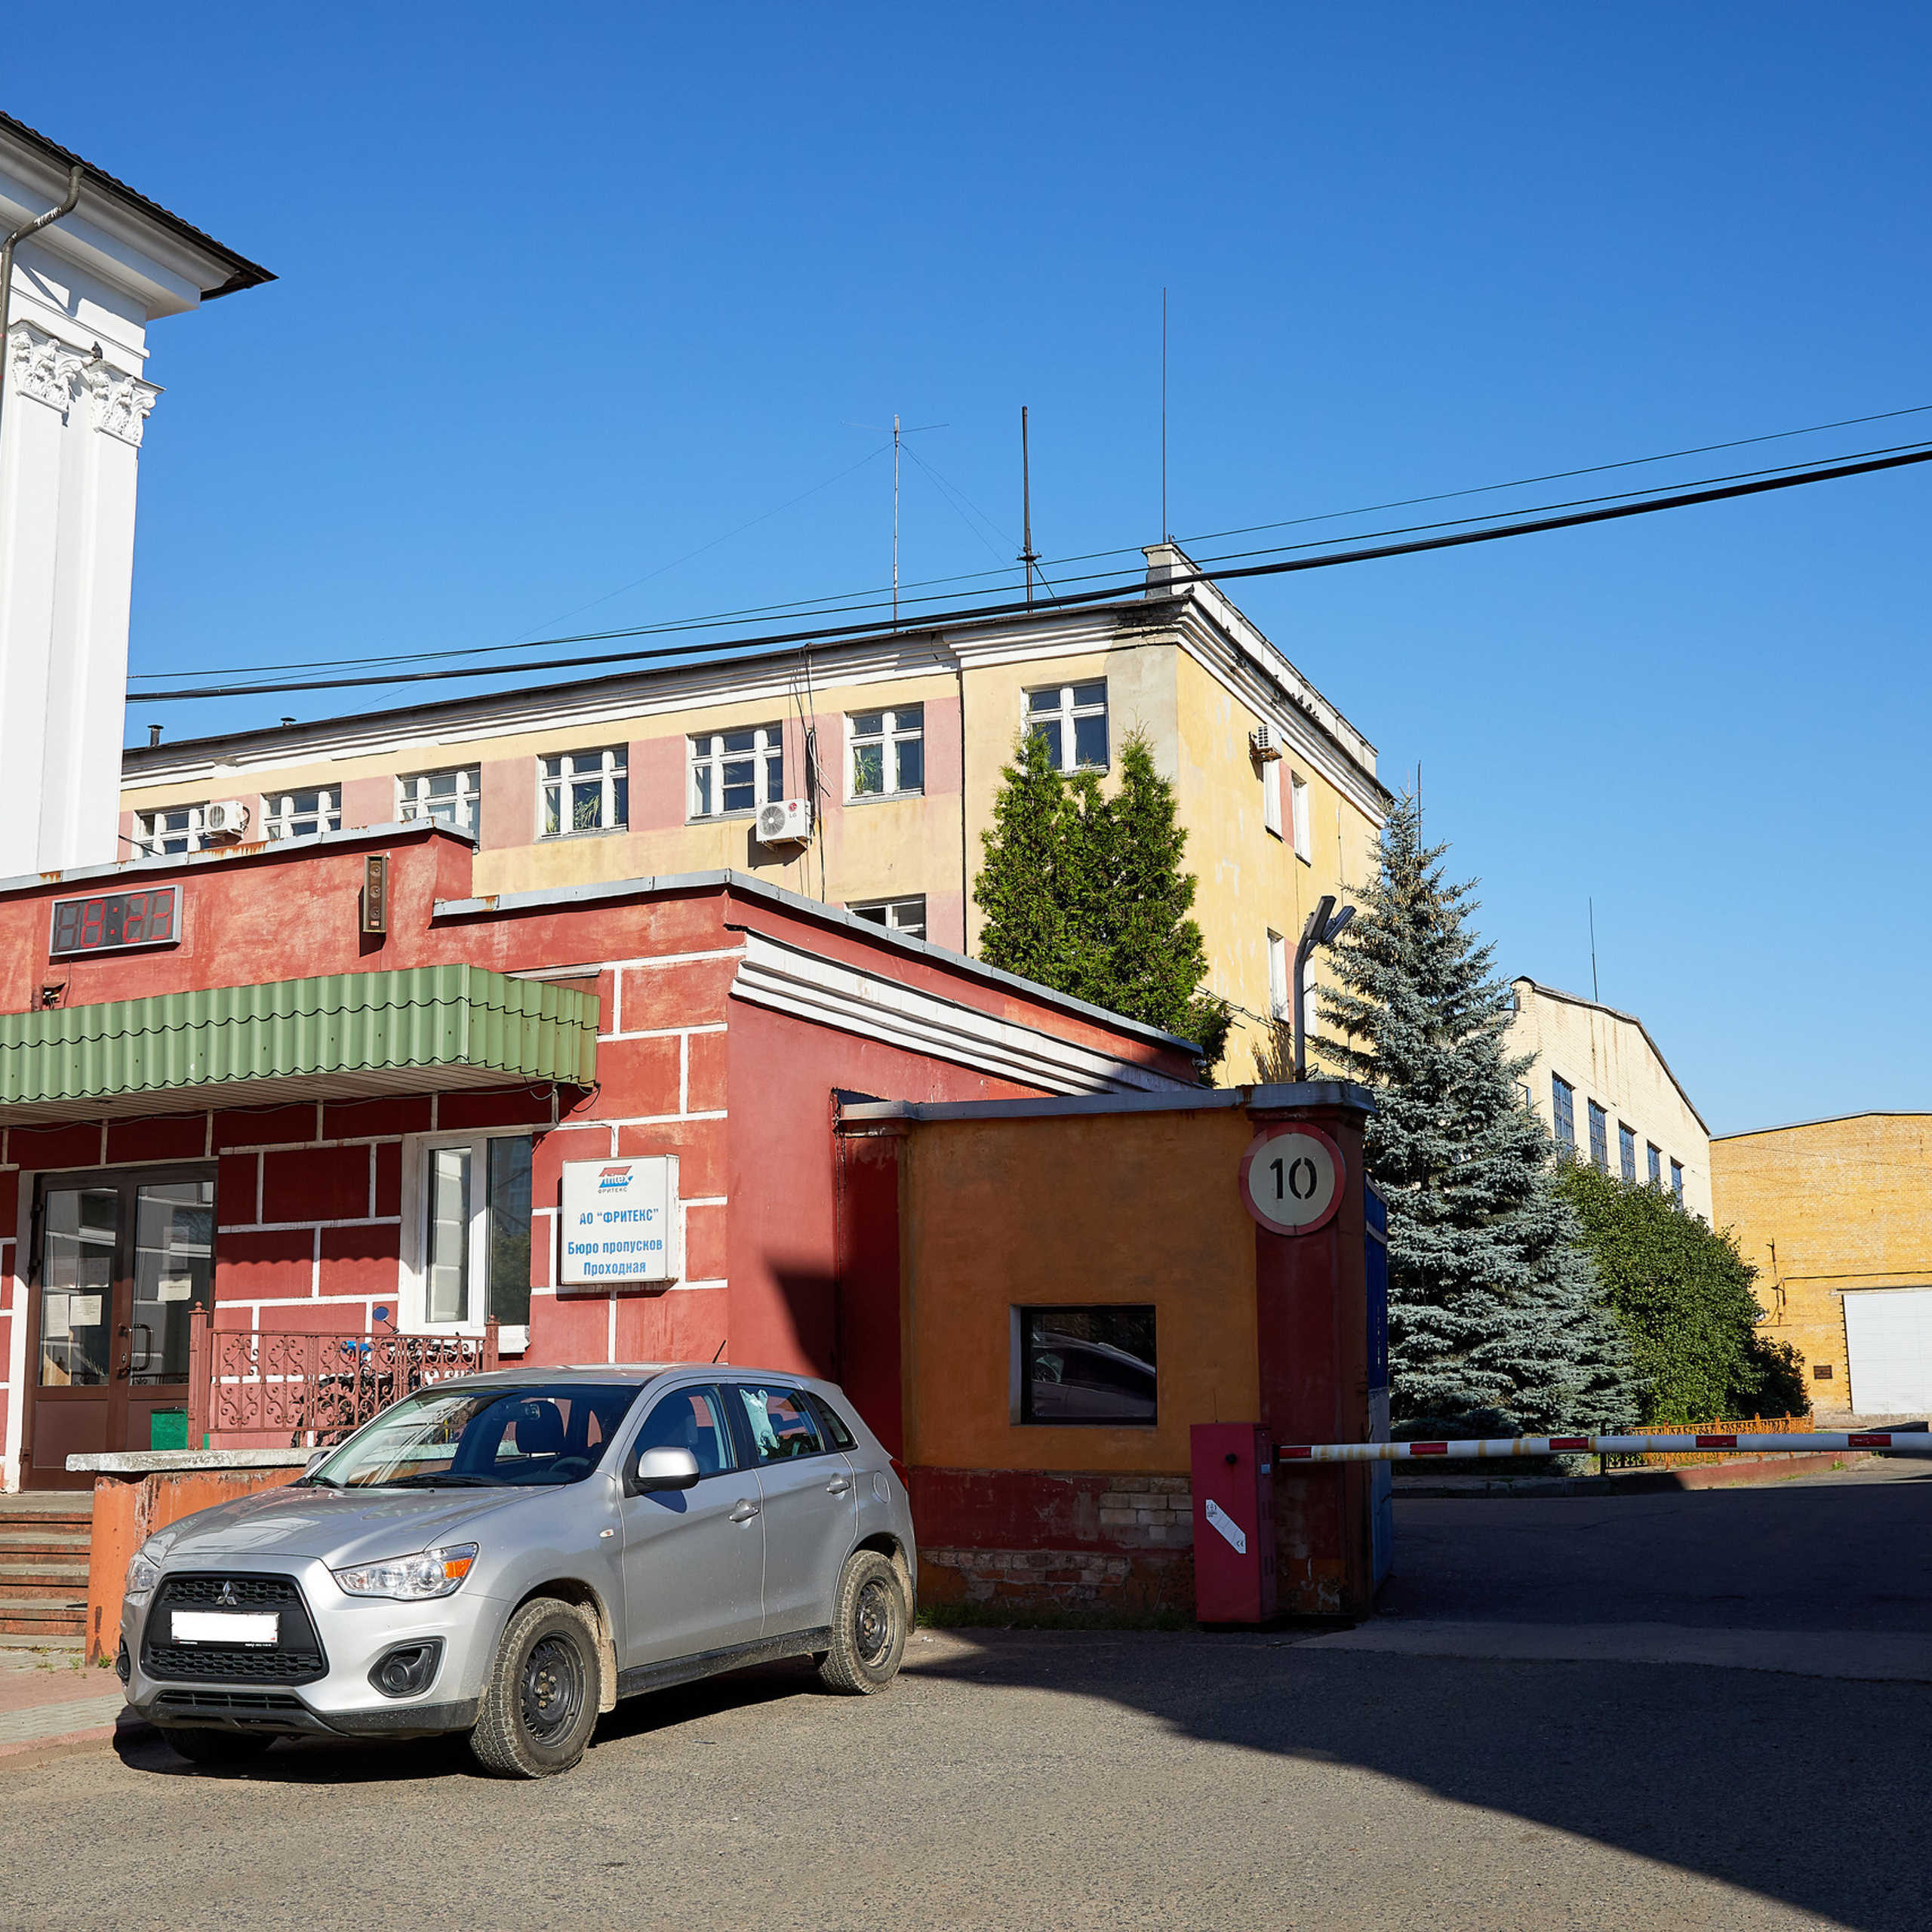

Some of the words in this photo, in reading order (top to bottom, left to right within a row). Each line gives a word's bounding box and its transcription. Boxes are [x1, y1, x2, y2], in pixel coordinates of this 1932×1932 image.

[80, 890, 174, 949] 8:23
[1269, 1157, 1317, 1200] 10
[580, 1212, 593, 1225] АО
[568, 1241, 599, 1256] Бюро
[602, 1239, 663, 1254] пропусков
[583, 1262, 646, 1276] Проходная
